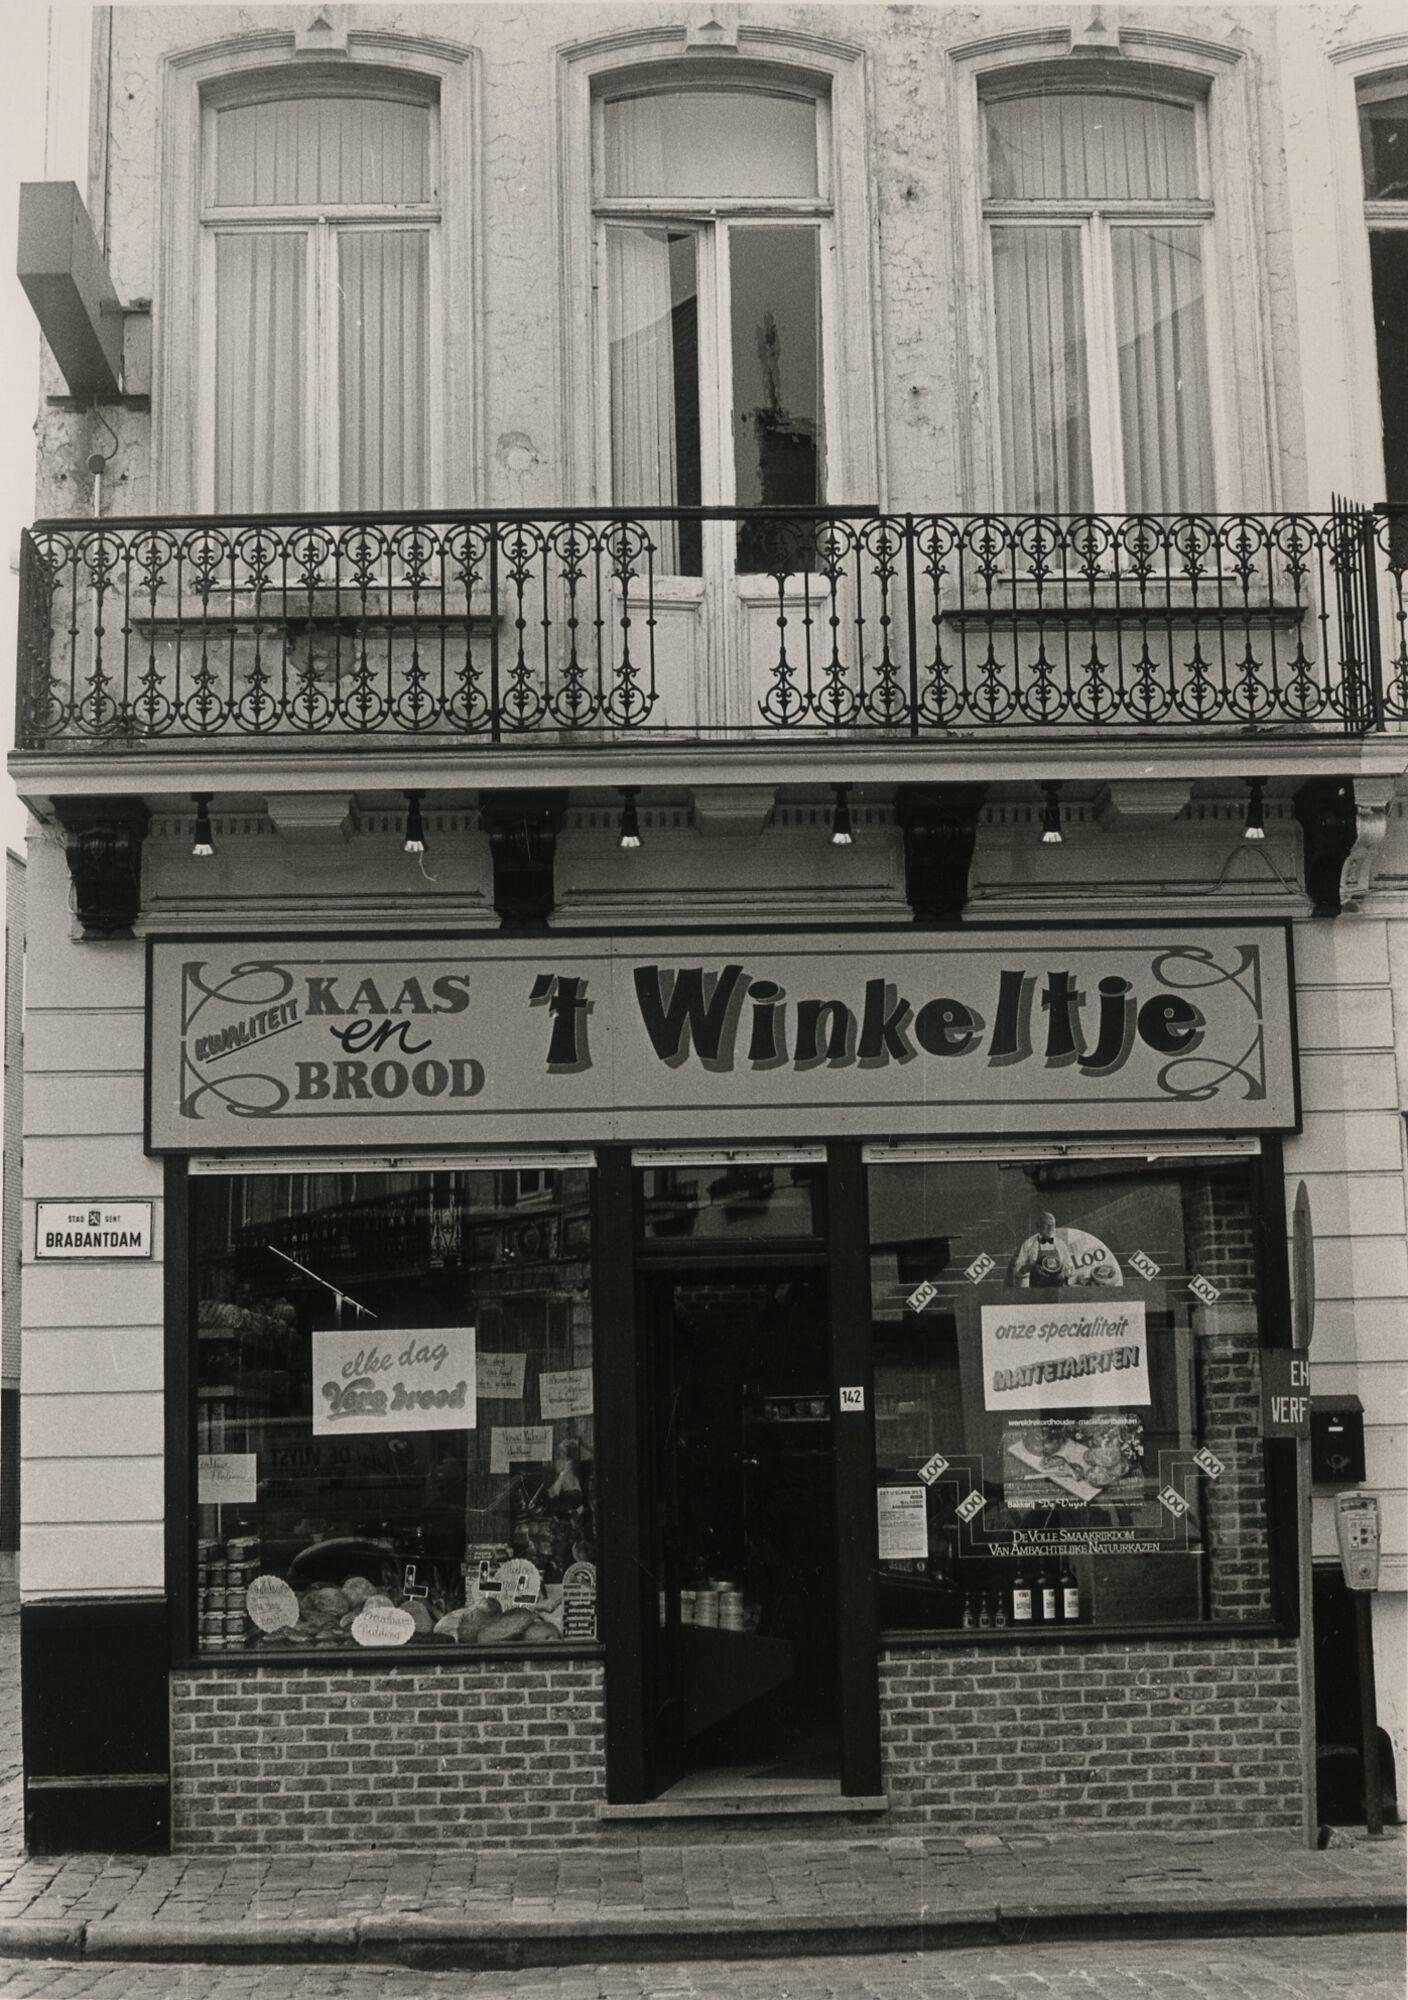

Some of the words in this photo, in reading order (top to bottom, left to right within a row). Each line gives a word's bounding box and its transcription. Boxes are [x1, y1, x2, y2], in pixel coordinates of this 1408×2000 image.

[305, 975, 471, 1016] KAAS
[194, 998, 299, 1061] KWALITEIT
[633, 964, 1206, 1077] Winkeltje
[330, 1019, 432, 1052] en
[295, 1057, 485, 1101] BROOD
[46, 1232, 142, 1248] BRABANTDAM
[967, 1255, 994, 1282] LOO
[1071, 1248, 1107, 1271] LOO
[1132, 1252, 1157, 1279] LOO
[909, 1284, 935, 1311] LOO
[1192, 1276, 1219, 1303] LOO
[995, 1321, 1037, 1340] onze
[1037, 1316, 1129, 1343] specialiteit
[341, 1346, 394, 1379] elke
[398, 1339, 449, 1372] dag
[993, 1345, 1140, 1392] MATTETAARTEN
[390, 1380, 467, 1411] brood
[842, 1390, 861, 1403] 142
[1271, 1397, 1308, 1423] VERF
[920, 1456, 947, 1482] LOO
[1195, 1450, 1223, 1477] LOO
[957, 1493, 984, 1520] LOO
[1160, 1488, 1188, 1514] LOO
